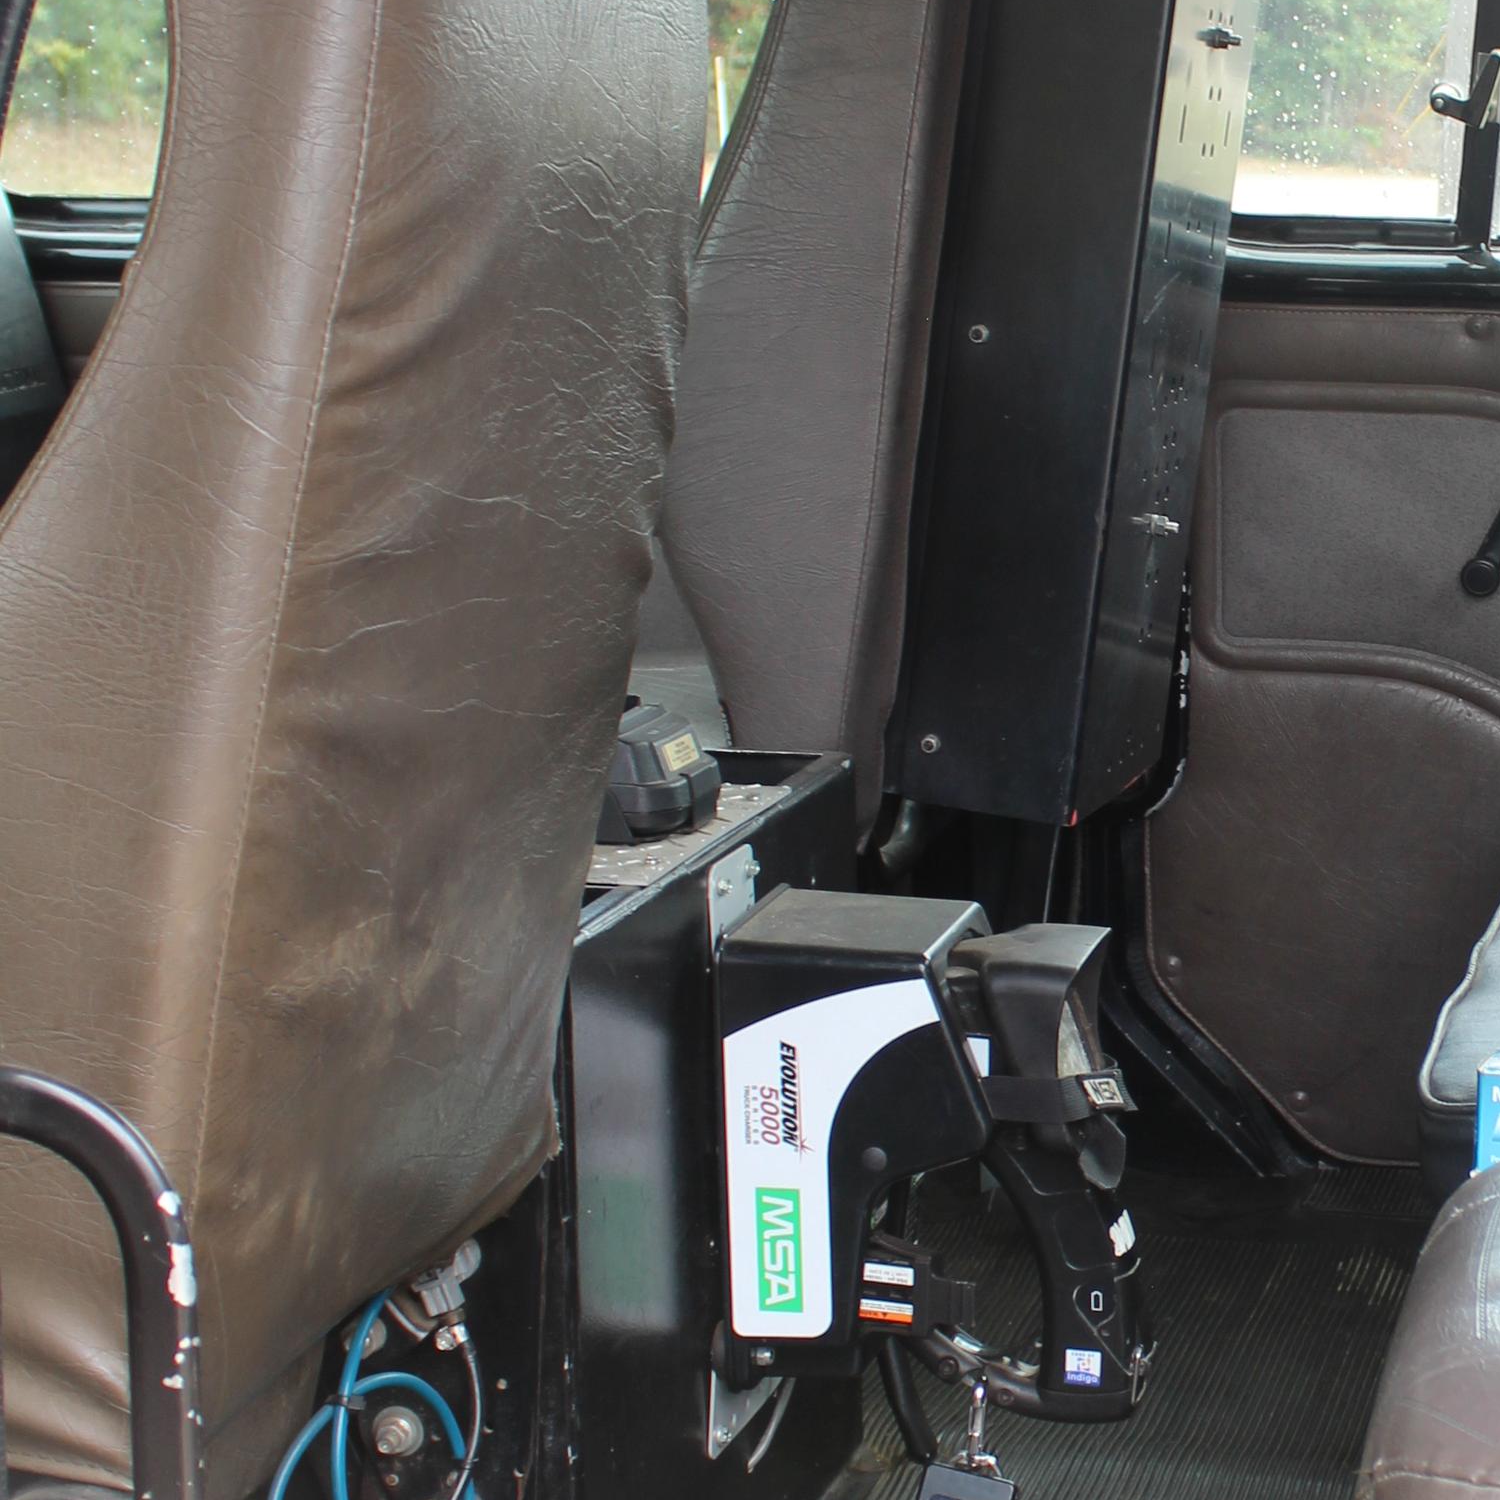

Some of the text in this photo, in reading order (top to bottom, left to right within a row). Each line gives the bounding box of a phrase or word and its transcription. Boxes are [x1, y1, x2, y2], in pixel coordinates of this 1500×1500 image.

[760, 1085, 780, 1145] 5000
[780, 1041, 799, 1150] EVOLUTION
[761, 1194, 796, 1306] MSA
